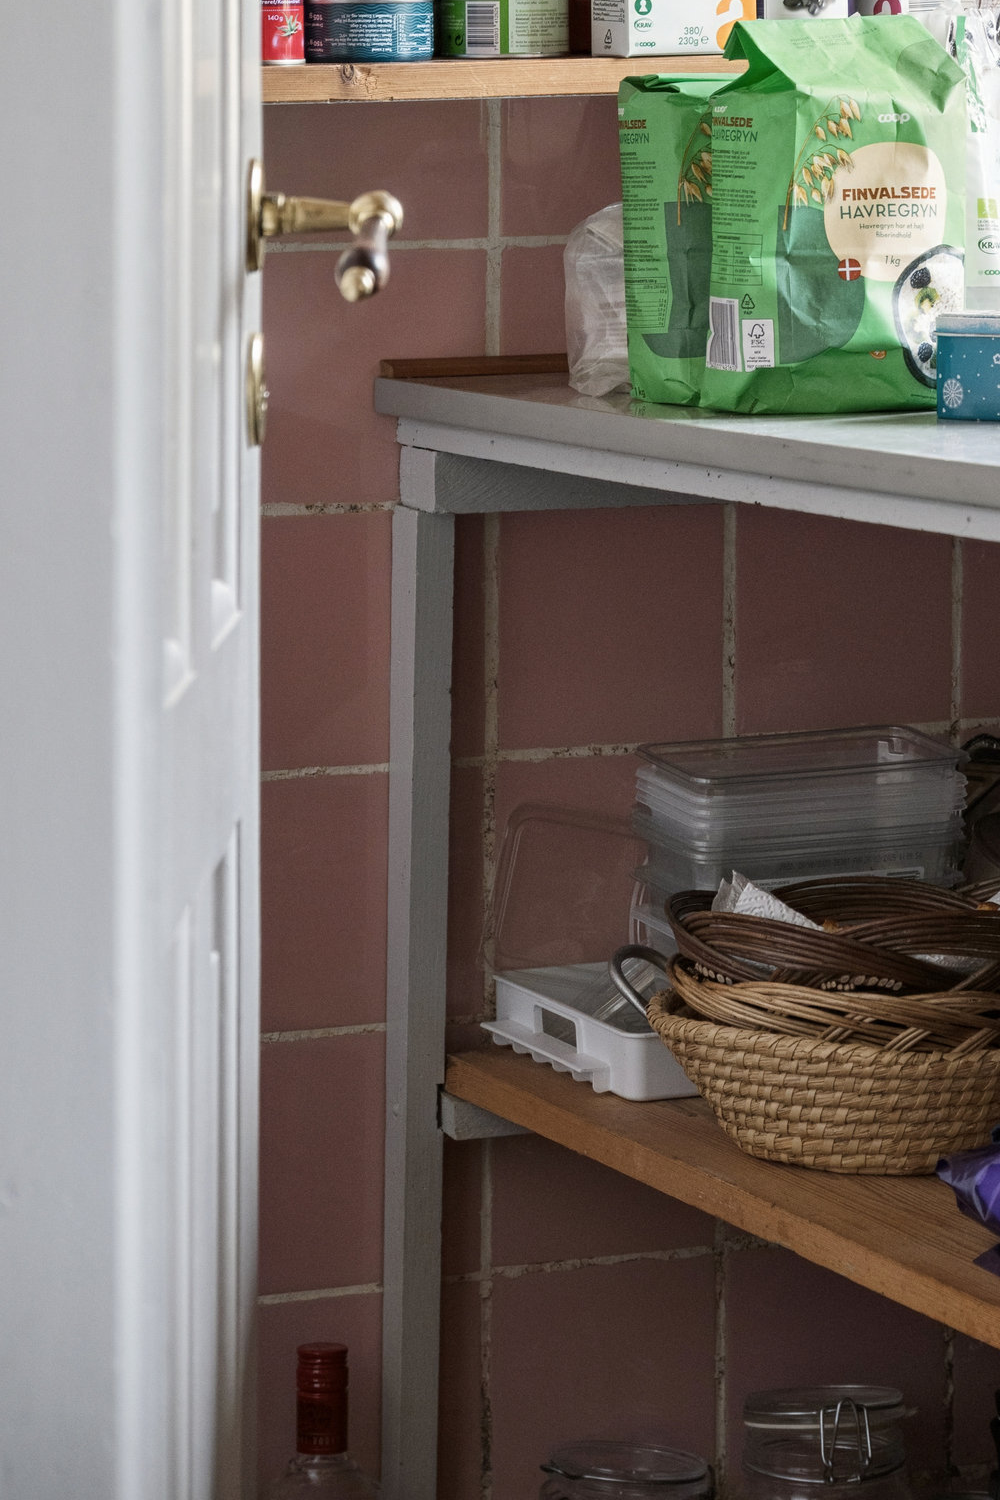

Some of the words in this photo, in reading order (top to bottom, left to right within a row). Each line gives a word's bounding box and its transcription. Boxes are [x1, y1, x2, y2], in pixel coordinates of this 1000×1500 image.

[878, 112, 911, 125] coop
[842, 186, 936, 201] FINVALSEDE
[840, 203, 938, 220] HAVREGRYN
[859, 223, 894, 231] Havregryn
[875, 231, 912, 239] fiberindhold
[890, 255, 901, 267] kg
